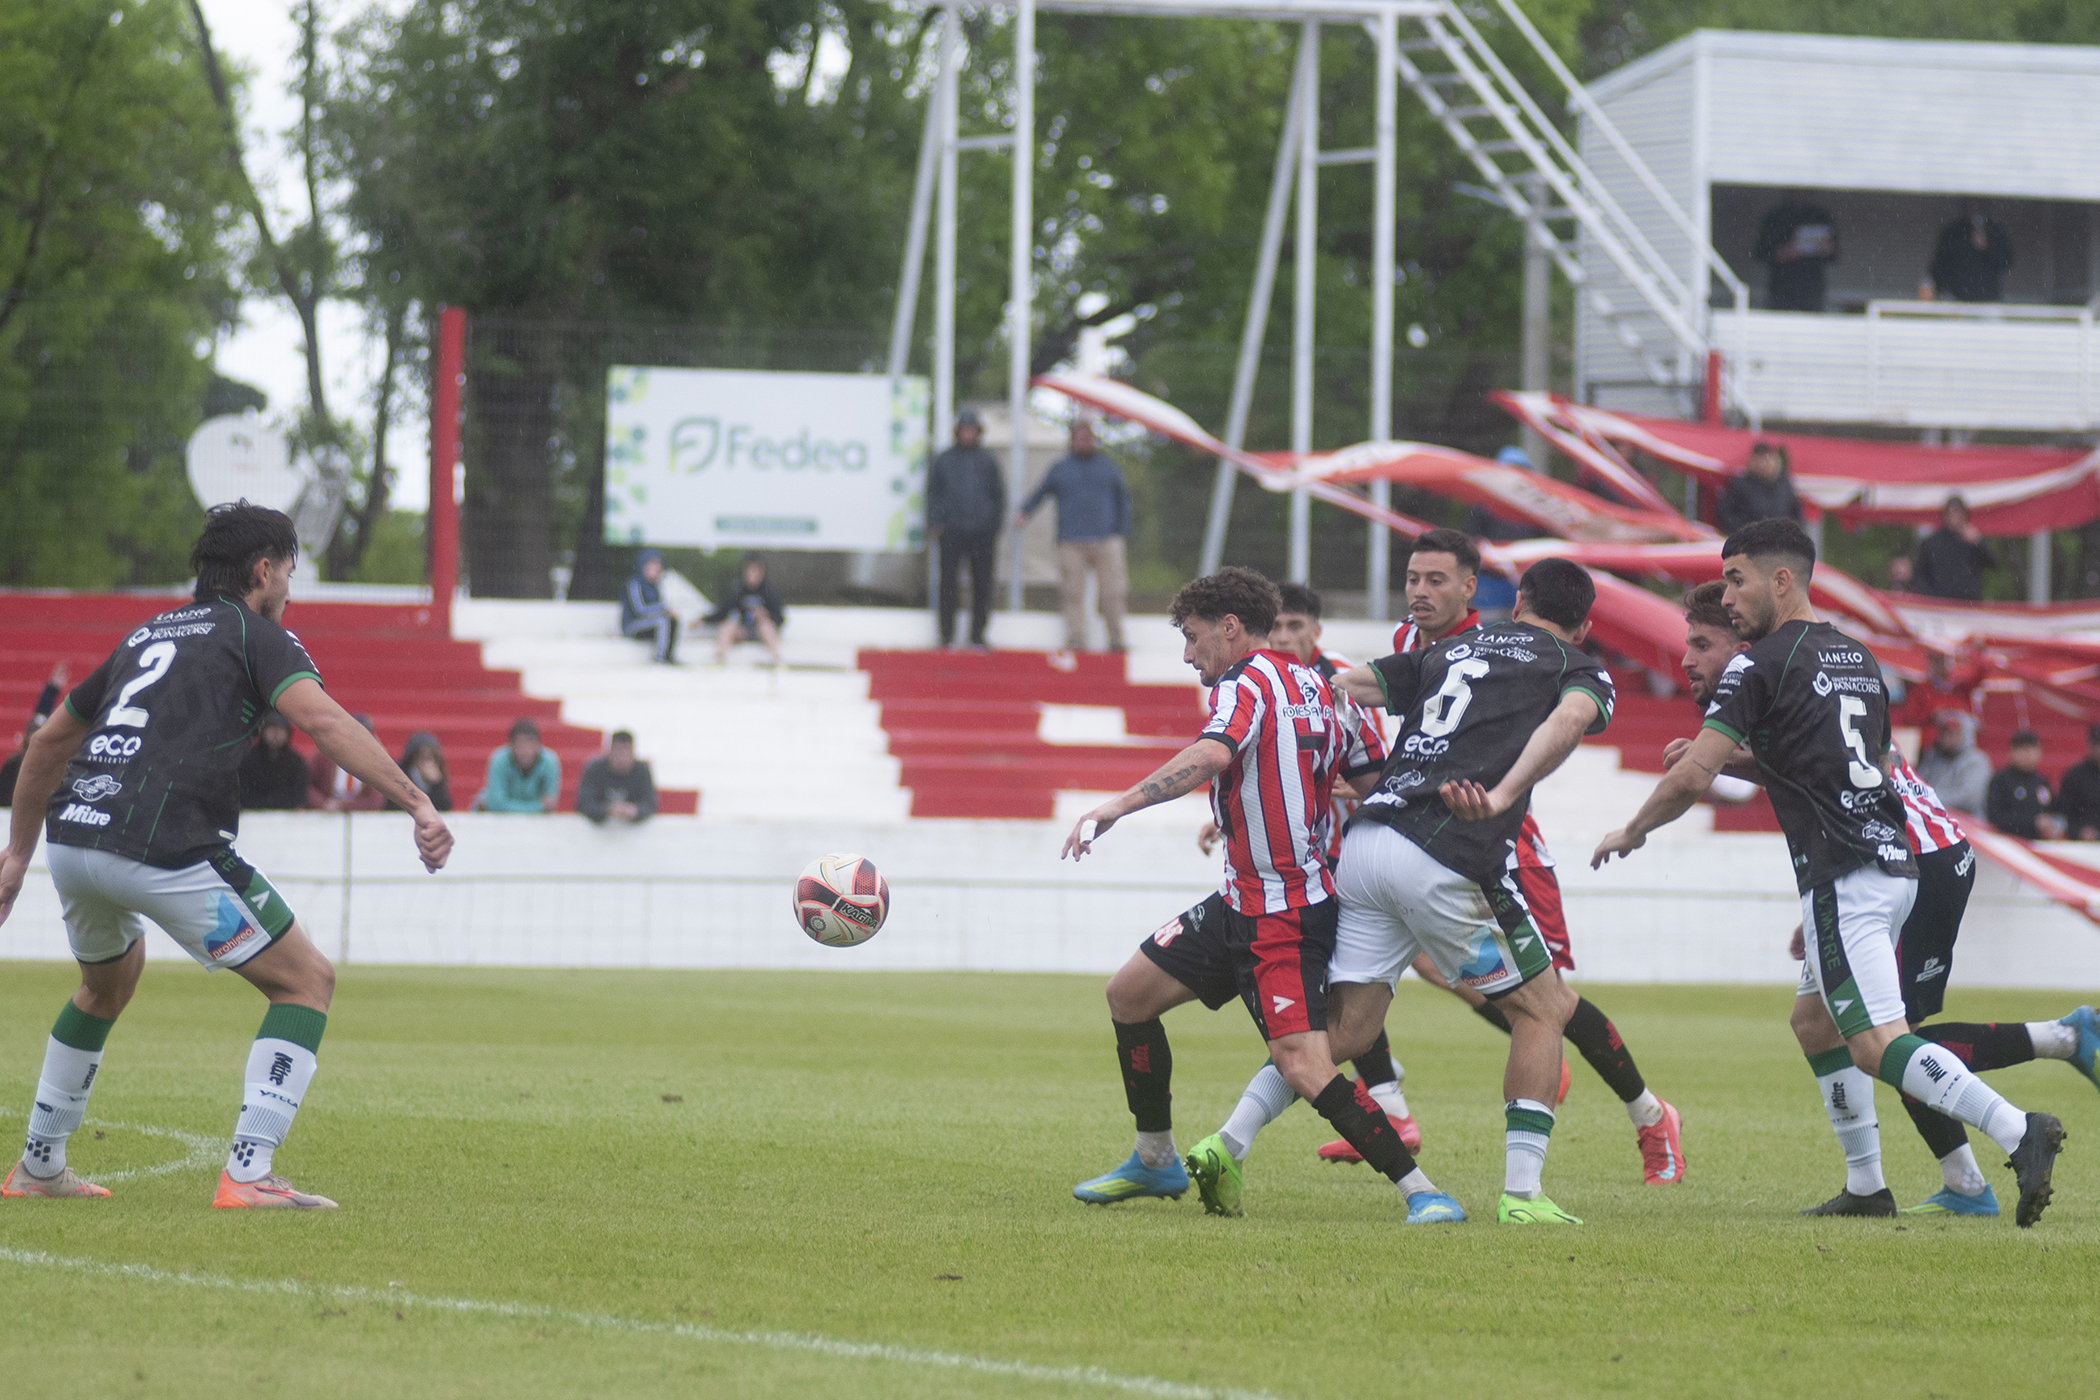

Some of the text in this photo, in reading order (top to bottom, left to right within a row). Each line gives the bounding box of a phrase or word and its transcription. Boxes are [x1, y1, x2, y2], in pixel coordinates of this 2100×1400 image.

[726, 424, 868, 472] Fedea
[1818, 651, 1863, 664] LANEKO
[106, 641, 177, 728] 2
[1420, 657, 1490, 738] 6
[1833, 682, 1880, 695] BONACORSI
[90, 734, 142, 757] eco
[1404, 734, 1449, 756] eco
[1839, 695, 1884, 789] 5
[1841, 789, 1887, 810] eco
[59, 803, 111, 826] Mitre
[841, 902, 879, 930] KAGIVA
[212, 927, 254, 959] prohigeo
[269, 1052, 294, 1086] Mitre
[1920, 1055, 1948, 1085] Mitre
